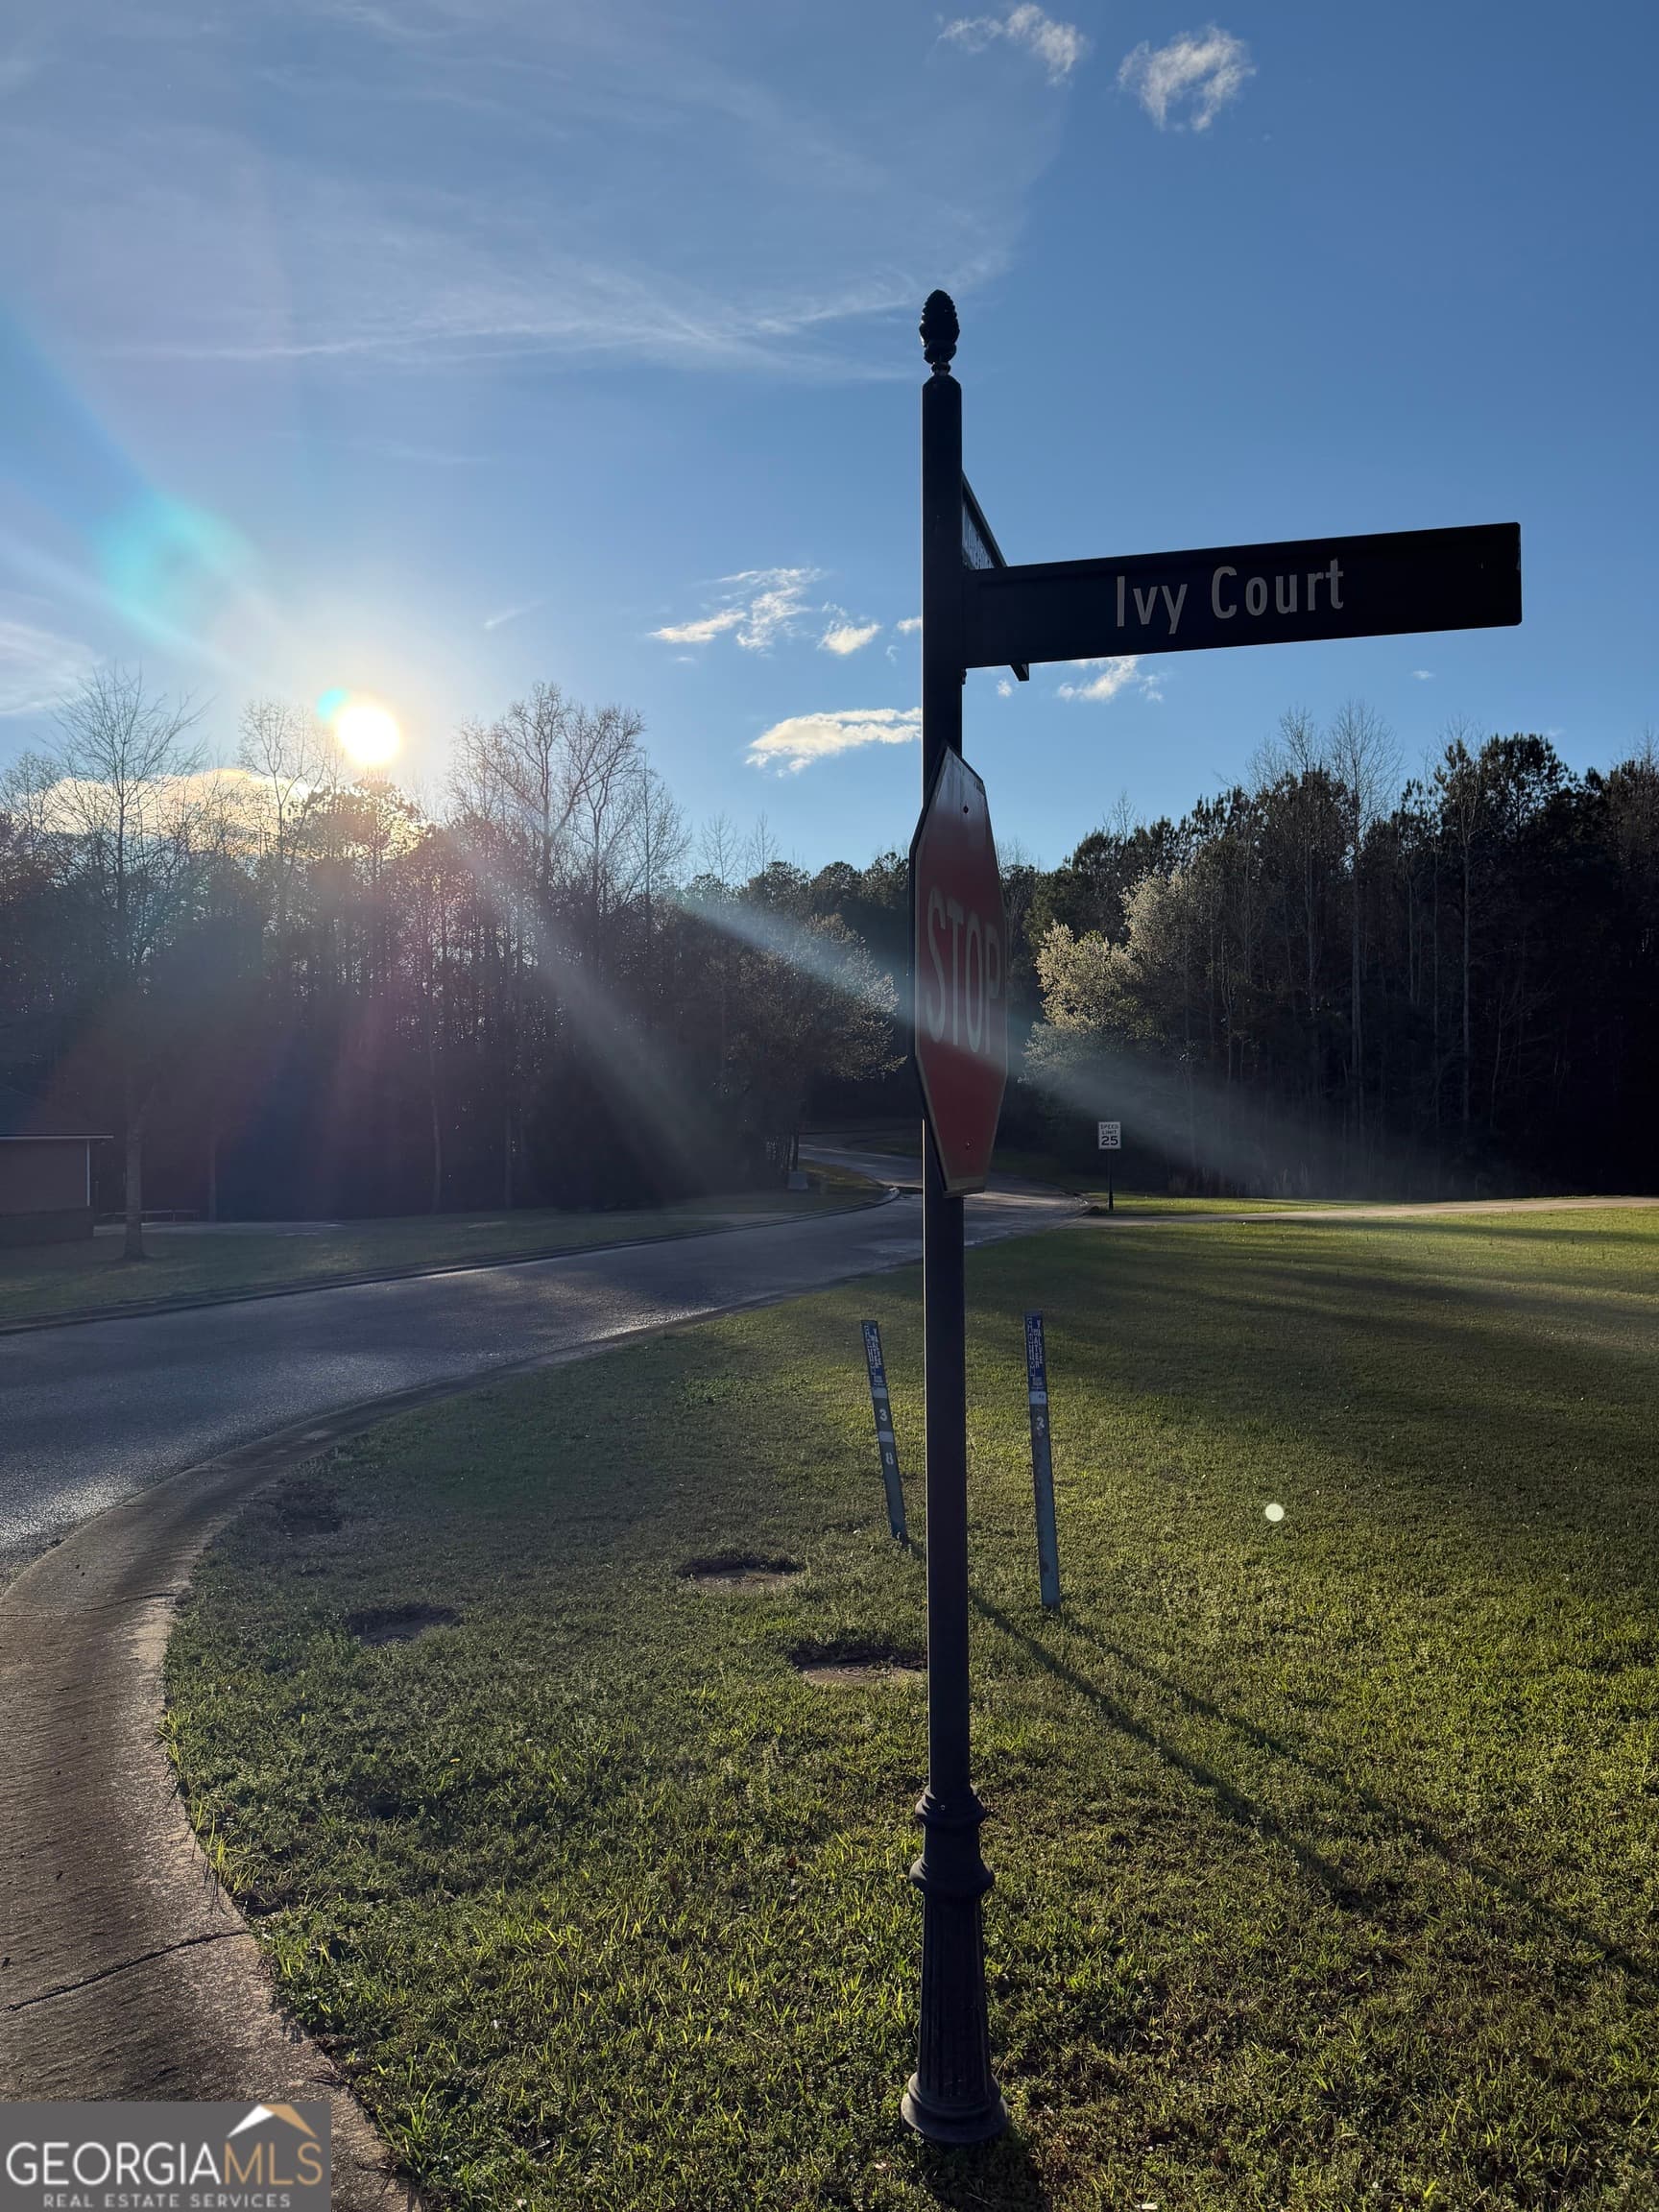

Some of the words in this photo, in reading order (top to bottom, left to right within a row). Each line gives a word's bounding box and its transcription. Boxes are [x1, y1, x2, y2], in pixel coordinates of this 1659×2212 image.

[1117, 576, 1188, 635] Ivy
[1211, 559, 1344, 619] Court
[926, 885, 1001, 1054] STOP
[1101, 1136, 1118, 1145] 25
[879, 1408, 888, 1422] 3
